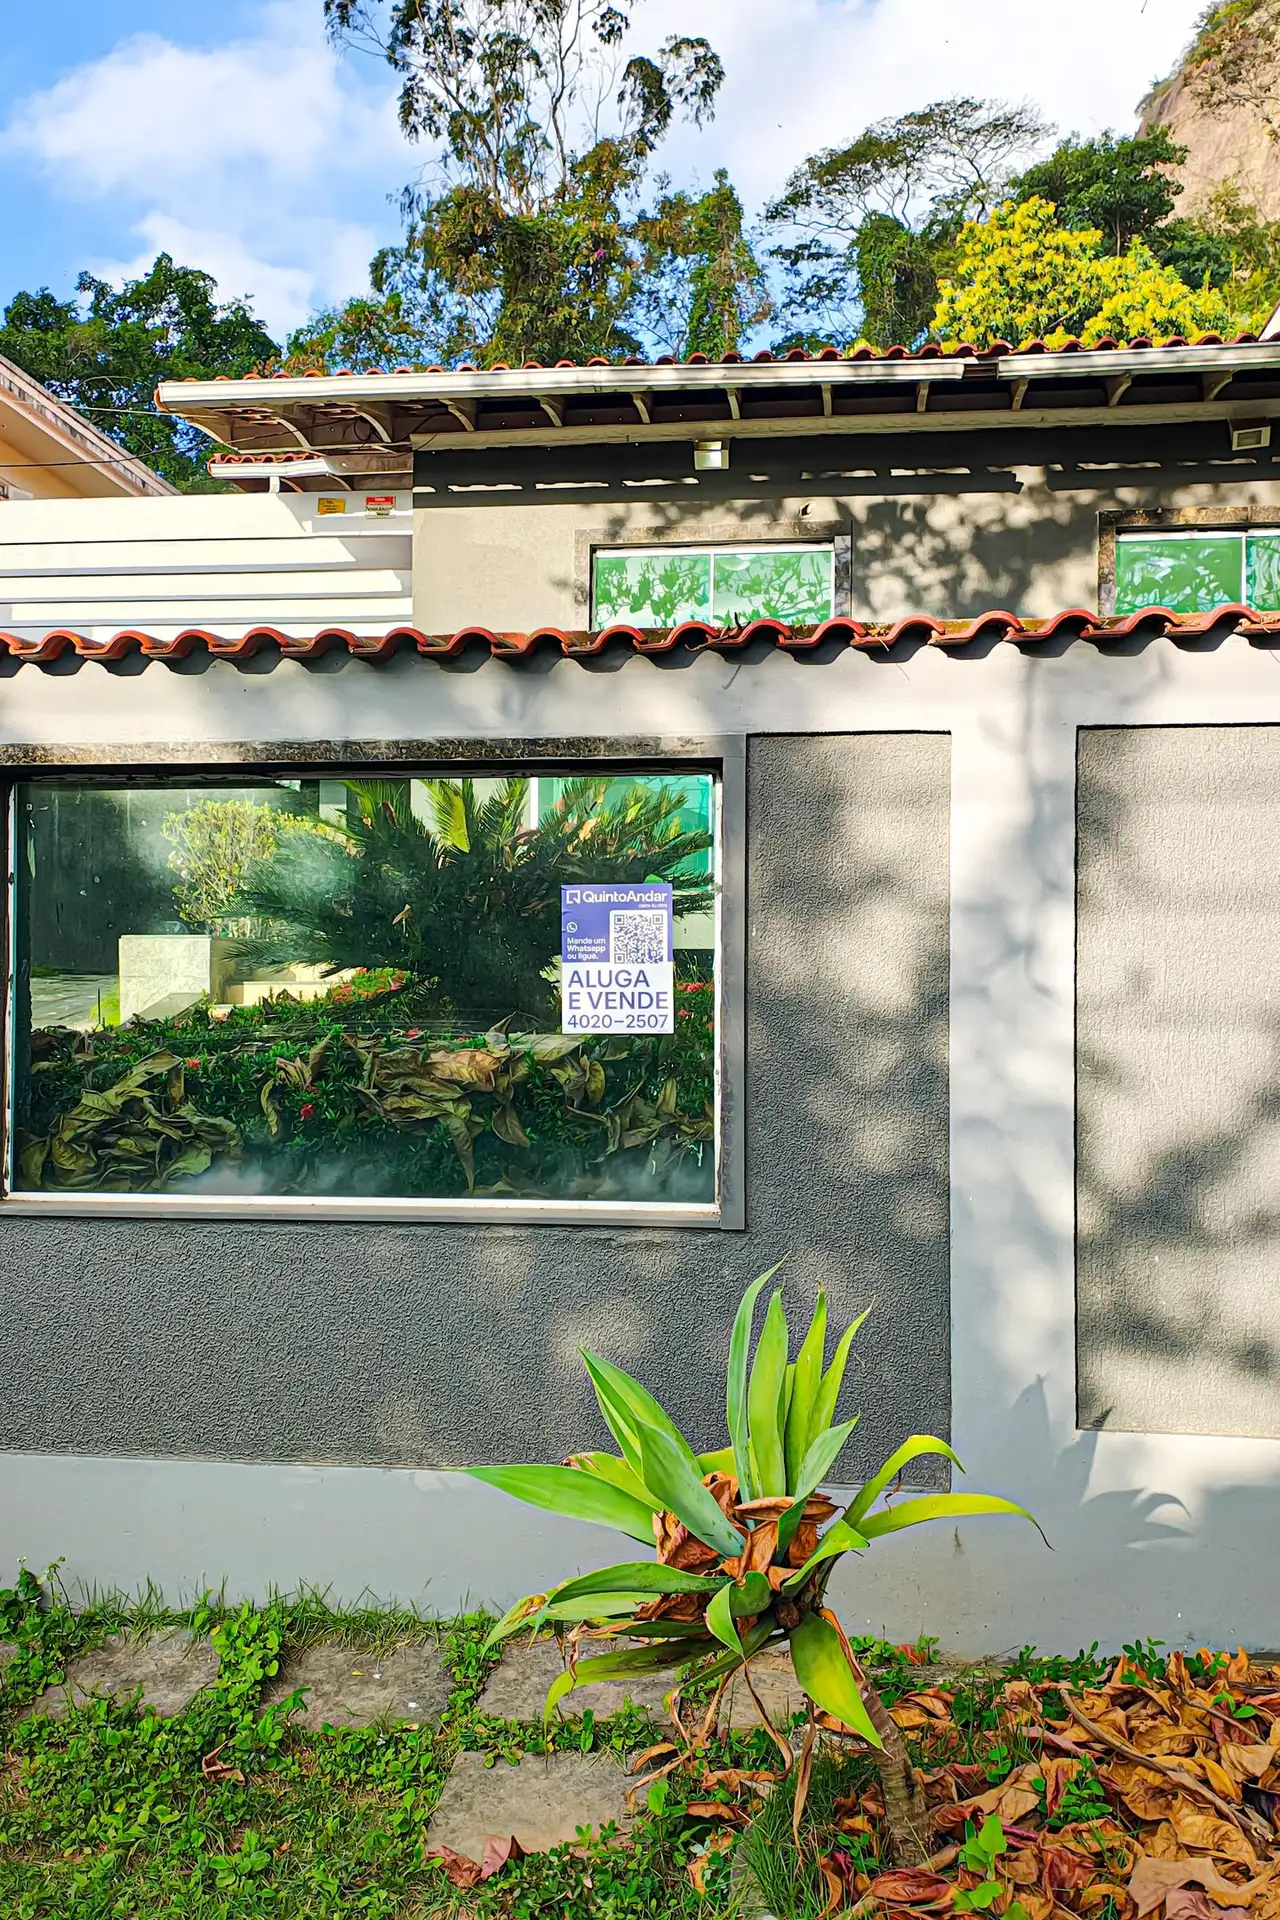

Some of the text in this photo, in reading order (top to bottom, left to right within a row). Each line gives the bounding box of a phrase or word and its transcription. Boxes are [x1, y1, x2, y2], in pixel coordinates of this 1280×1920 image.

[582, 890, 668, 904] QuintoAndar
[567, 937, 592, 945] Mande
[567, 945, 606, 953] Whatsapp
[578, 952, 598, 961] ligue.
[568, 969, 650, 988] ALUGA
[569, 991, 668, 1010] E VENDE
[567, 1014, 668, 1029] 4020-2507
